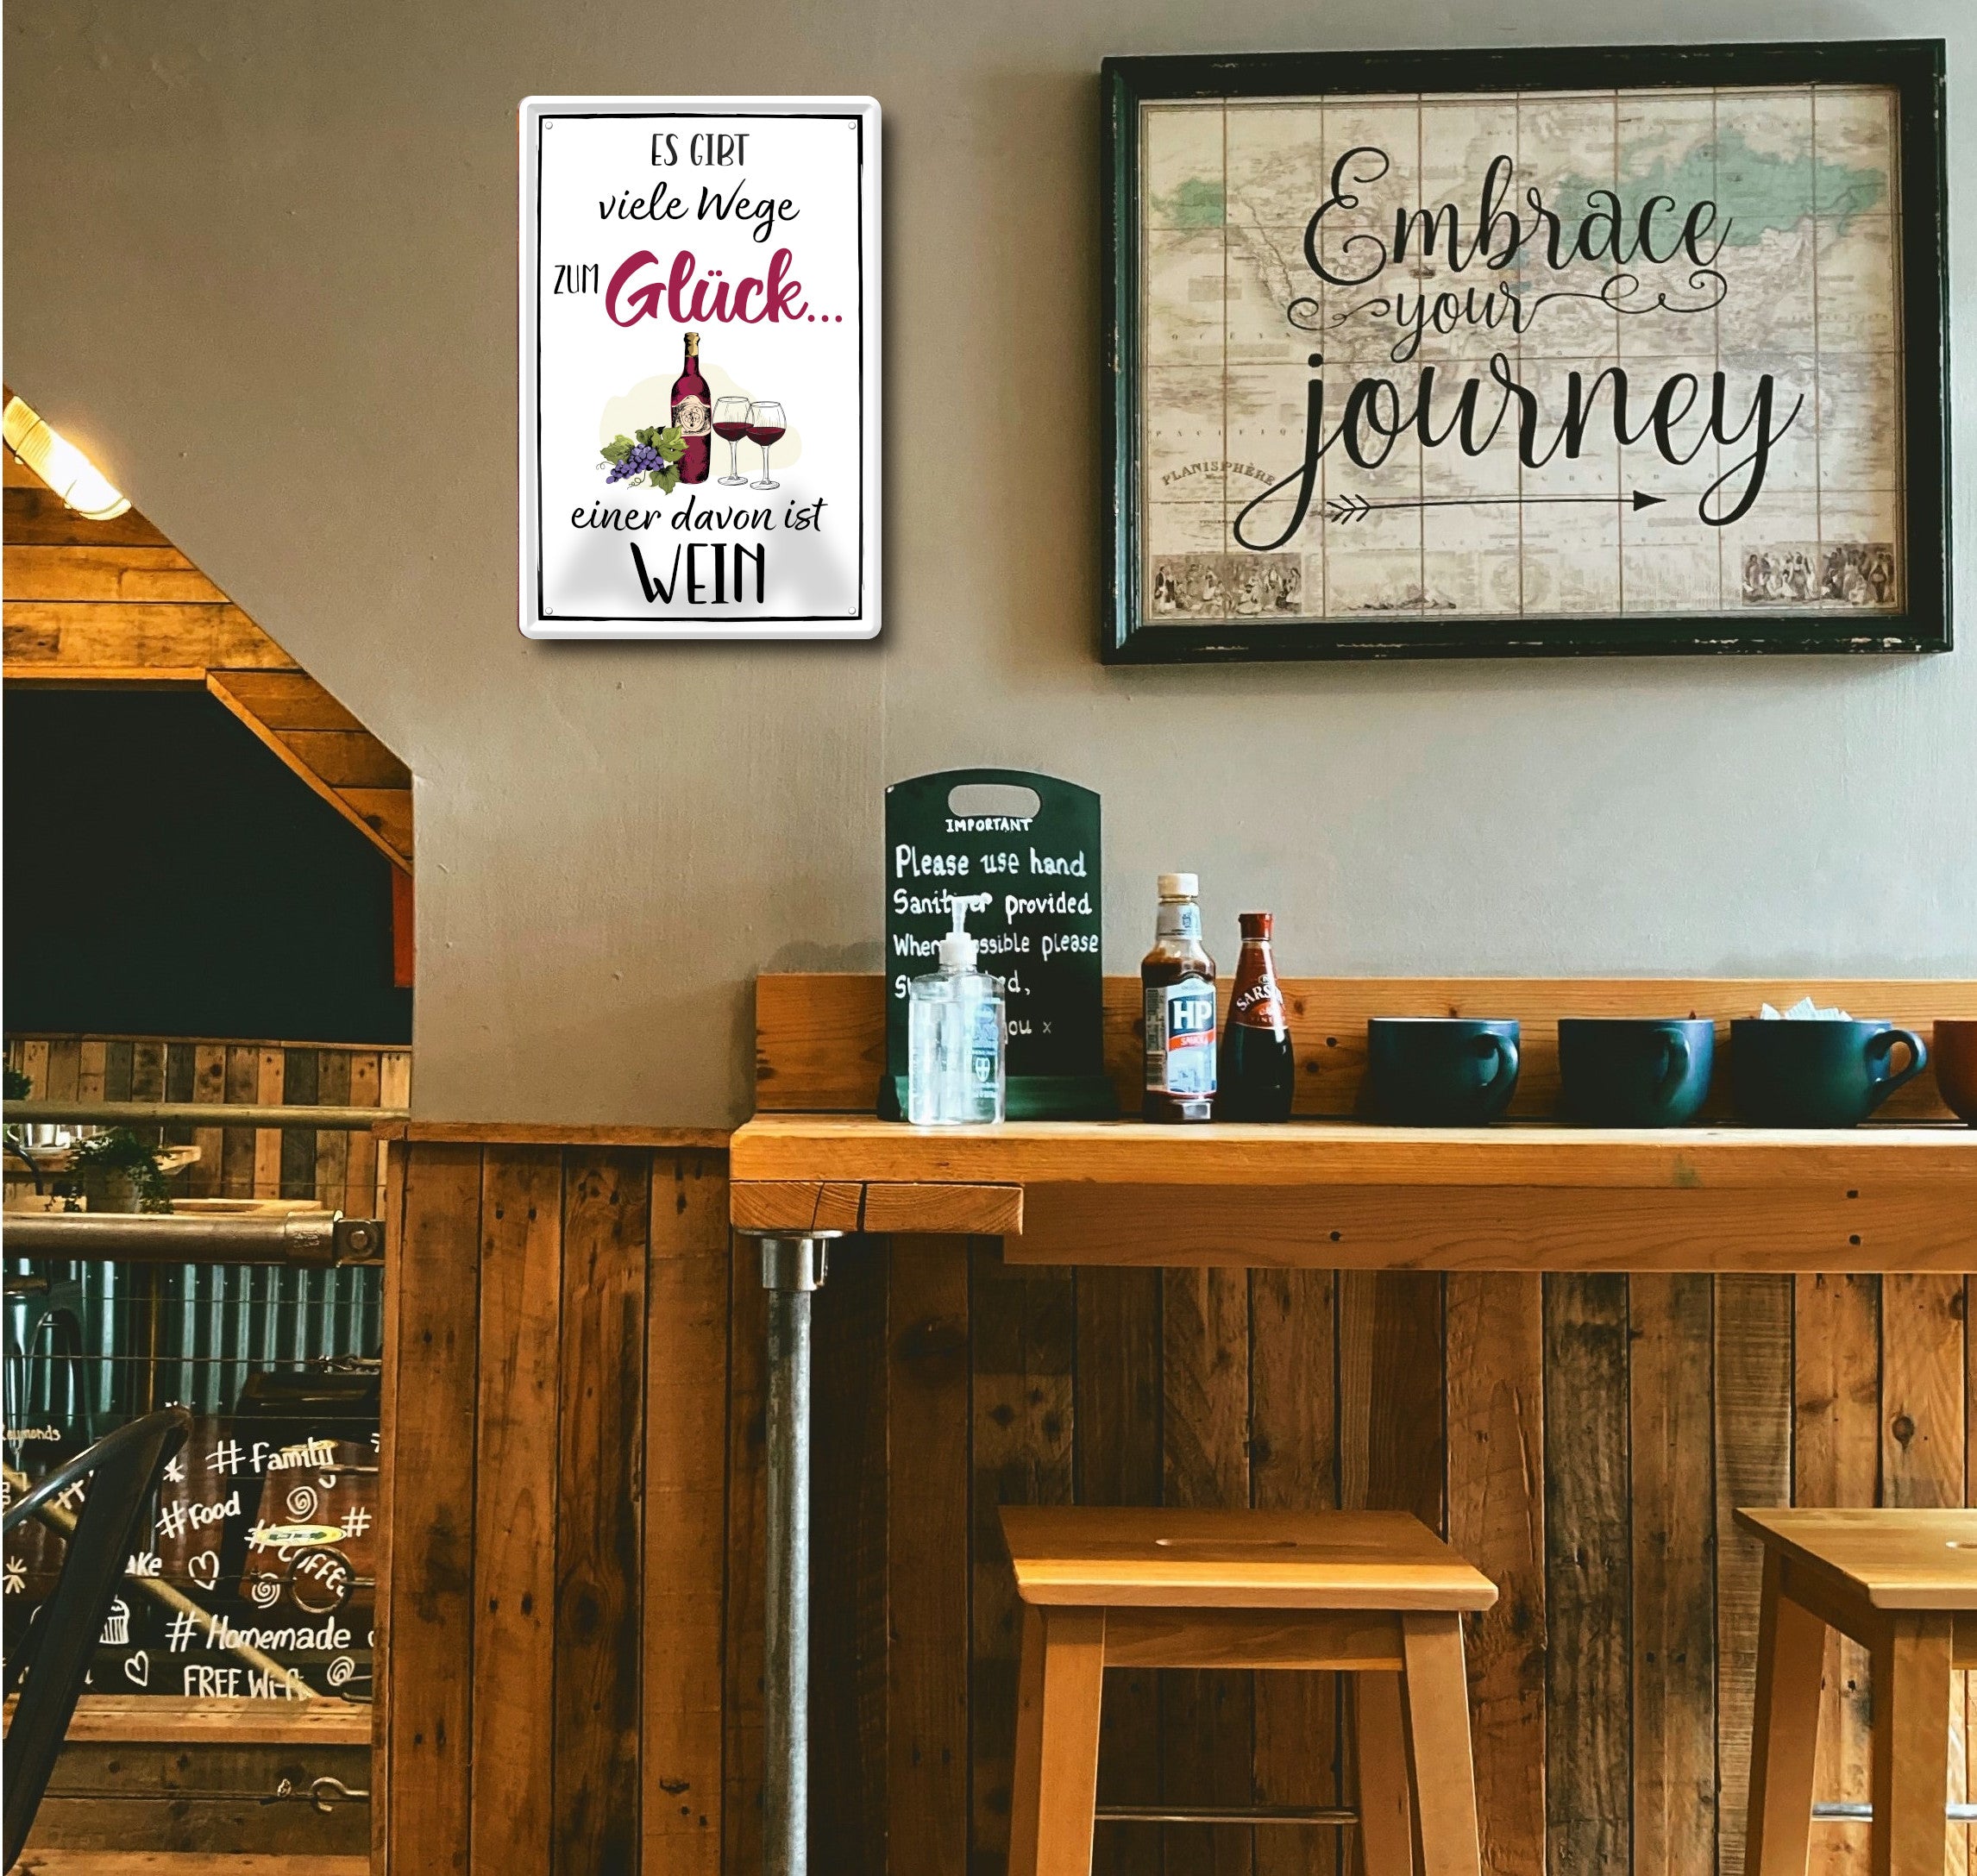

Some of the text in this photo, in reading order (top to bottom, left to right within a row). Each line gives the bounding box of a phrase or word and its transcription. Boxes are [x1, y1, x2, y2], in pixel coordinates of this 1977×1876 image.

[652, 133, 750, 166] ES GIBT
[599, 179, 800, 243] viele Wege
[1303, 147, 1733, 285] Embrace
[555, 248, 843, 328] ZUM Glück...
[1233, 353, 1804, 551] journey
[1161, 461, 1277, 486] PLANISPHÈRE
[571, 494, 828, 532] einer davon ist
[631, 542, 765, 605] WEIN
[945, 818, 1033, 832] IMPORTANT
[895, 844, 1088, 878] Please use hand
[1005, 891, 1093, 925] provided
[1041, 932, 1099, 962] please
[1174, 1001, 1213, 1030] HP
[184, 1664, 242, 1699] FREE
